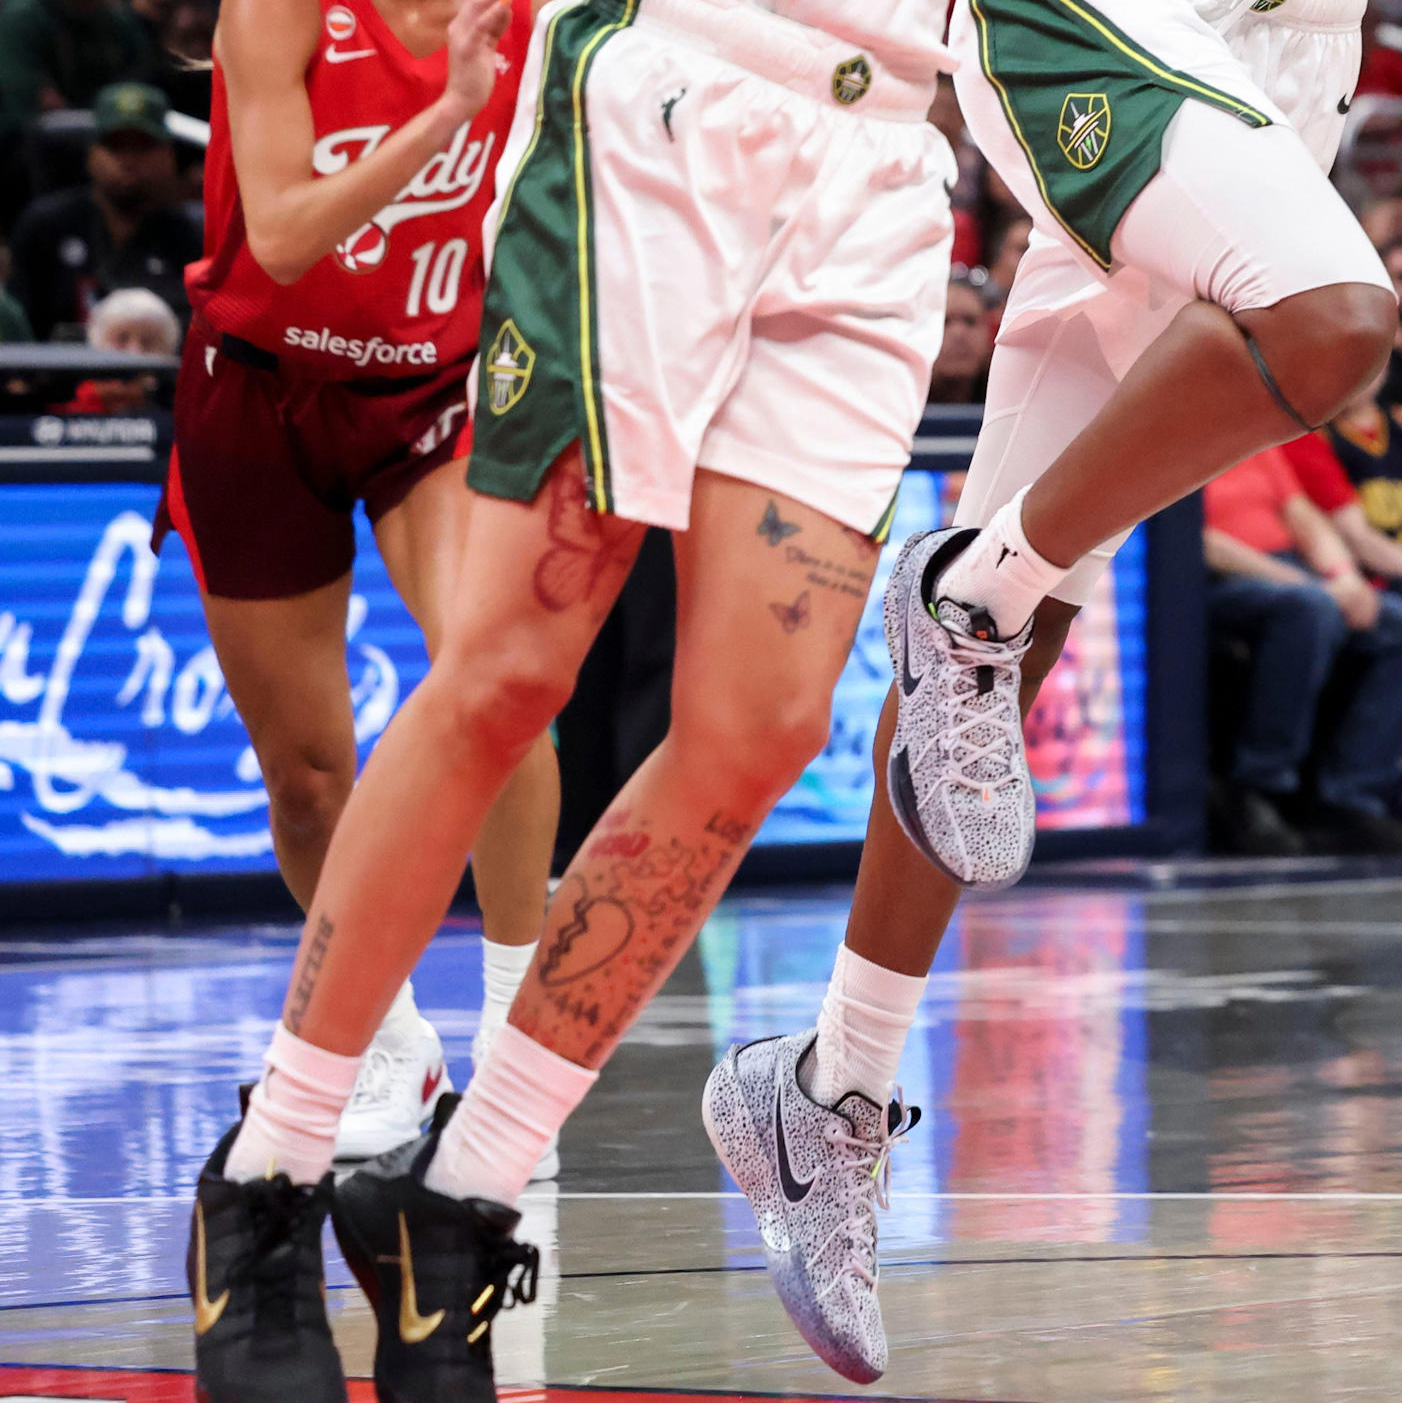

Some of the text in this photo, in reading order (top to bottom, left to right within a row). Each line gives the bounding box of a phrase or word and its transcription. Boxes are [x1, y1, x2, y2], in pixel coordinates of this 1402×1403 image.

[313, 121, 496, 206] Idy
[406, 238, 468, 317] 10
[284, 325, 438, 367] salesforce
